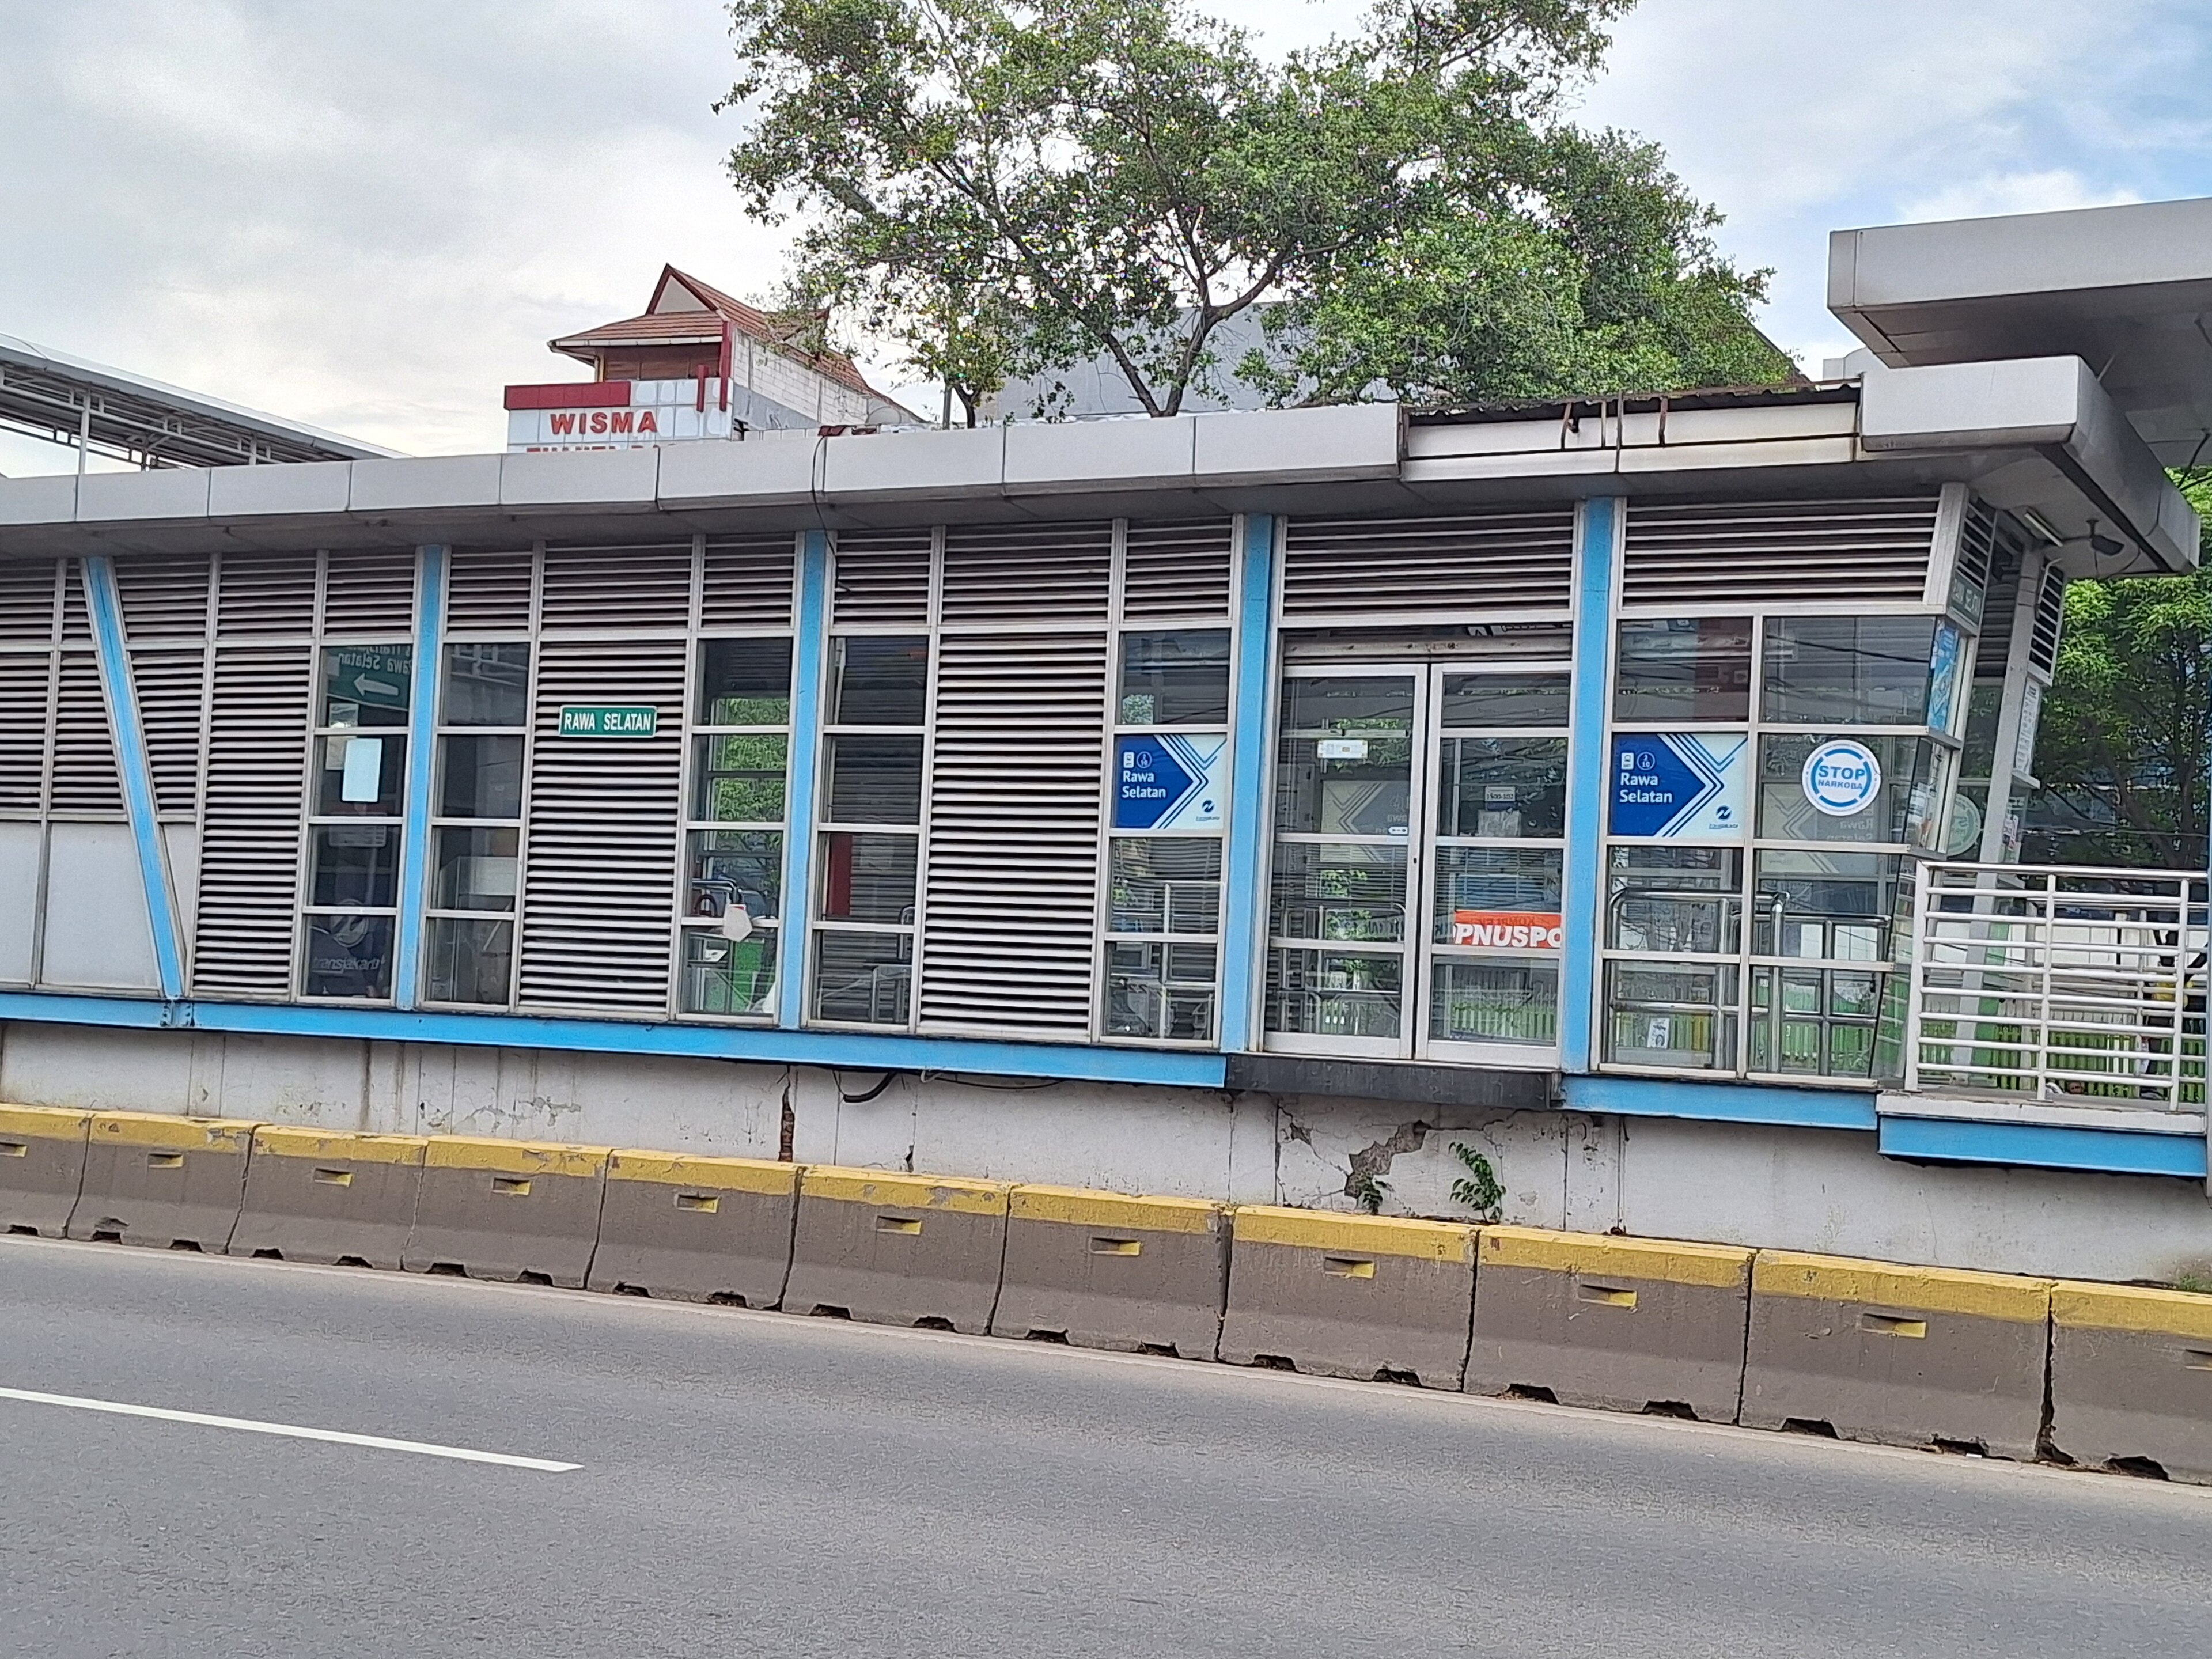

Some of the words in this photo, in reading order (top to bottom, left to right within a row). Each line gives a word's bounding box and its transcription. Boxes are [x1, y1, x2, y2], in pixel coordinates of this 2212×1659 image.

[550, 411, 657, 434] WISMA
[564, 713, 596, 730] RAWA
[603, 713, 652, 731] SELATAN
[1123, 770, 1154, 782] Rawa
[1620, 772, 1658, 786] Rawa
[1819, 765, 1865, 780] STOP
[1122, 785, 1166, 798] Selatan
[1619, 789, 1672, 803] Selatan
[1453, 923, 1562, 948] PNUSPO
